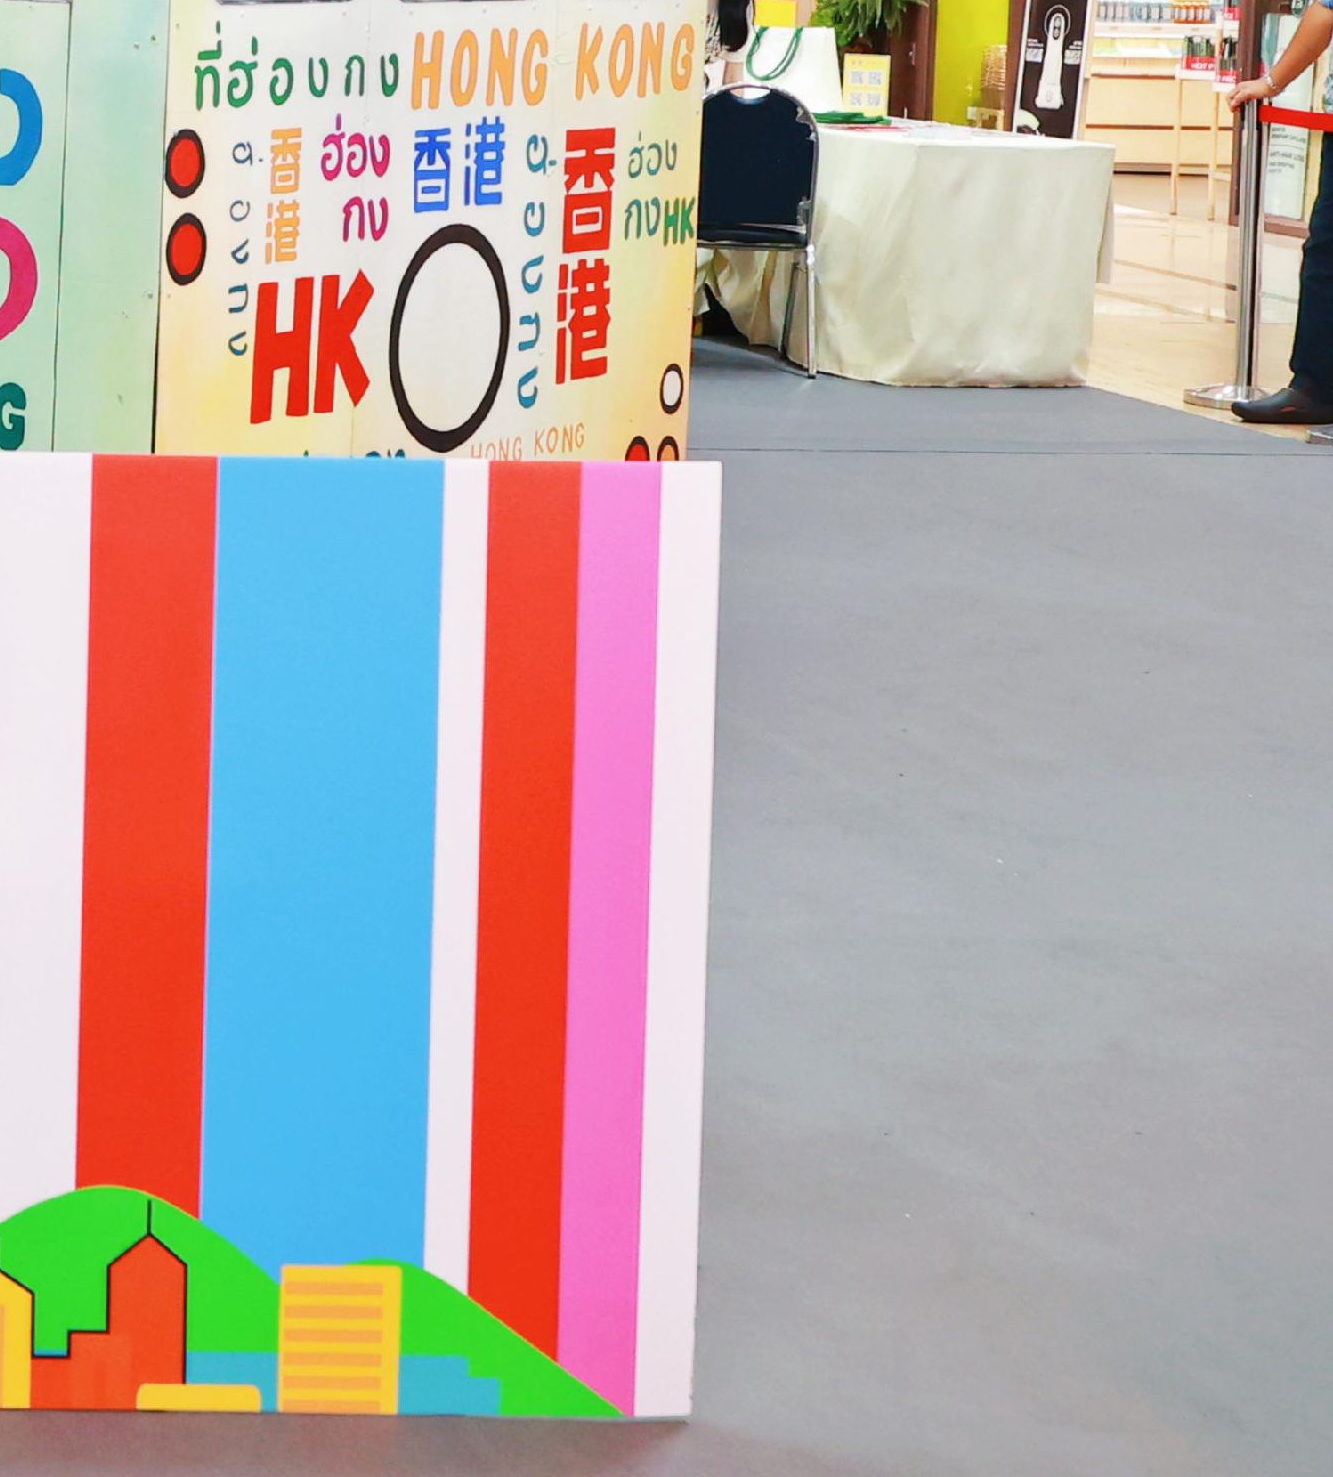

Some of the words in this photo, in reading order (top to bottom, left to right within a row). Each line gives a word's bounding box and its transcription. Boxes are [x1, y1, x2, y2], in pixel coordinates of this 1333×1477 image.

[195, 20, 400, 111] ที่ฮ่องกง
[411, 27, 549, 110] HONG
[574, 21, 695, 101] KONG
[320, 112, 391, 182] ฮ่อง
[413, 115, 506, 214] 香港
[627, 132, 677, 179] ฮ่อง
[265, 127, 303, 265] 香港
[341, 196, 389, 242] กง
[623, 200, 659, 241] กง
[659, 195, 695, 247] HK
[555, 127, 617, 385] 香港
[250, 268, 375, 424] HK
[534, 422, 585, 457] KONG
